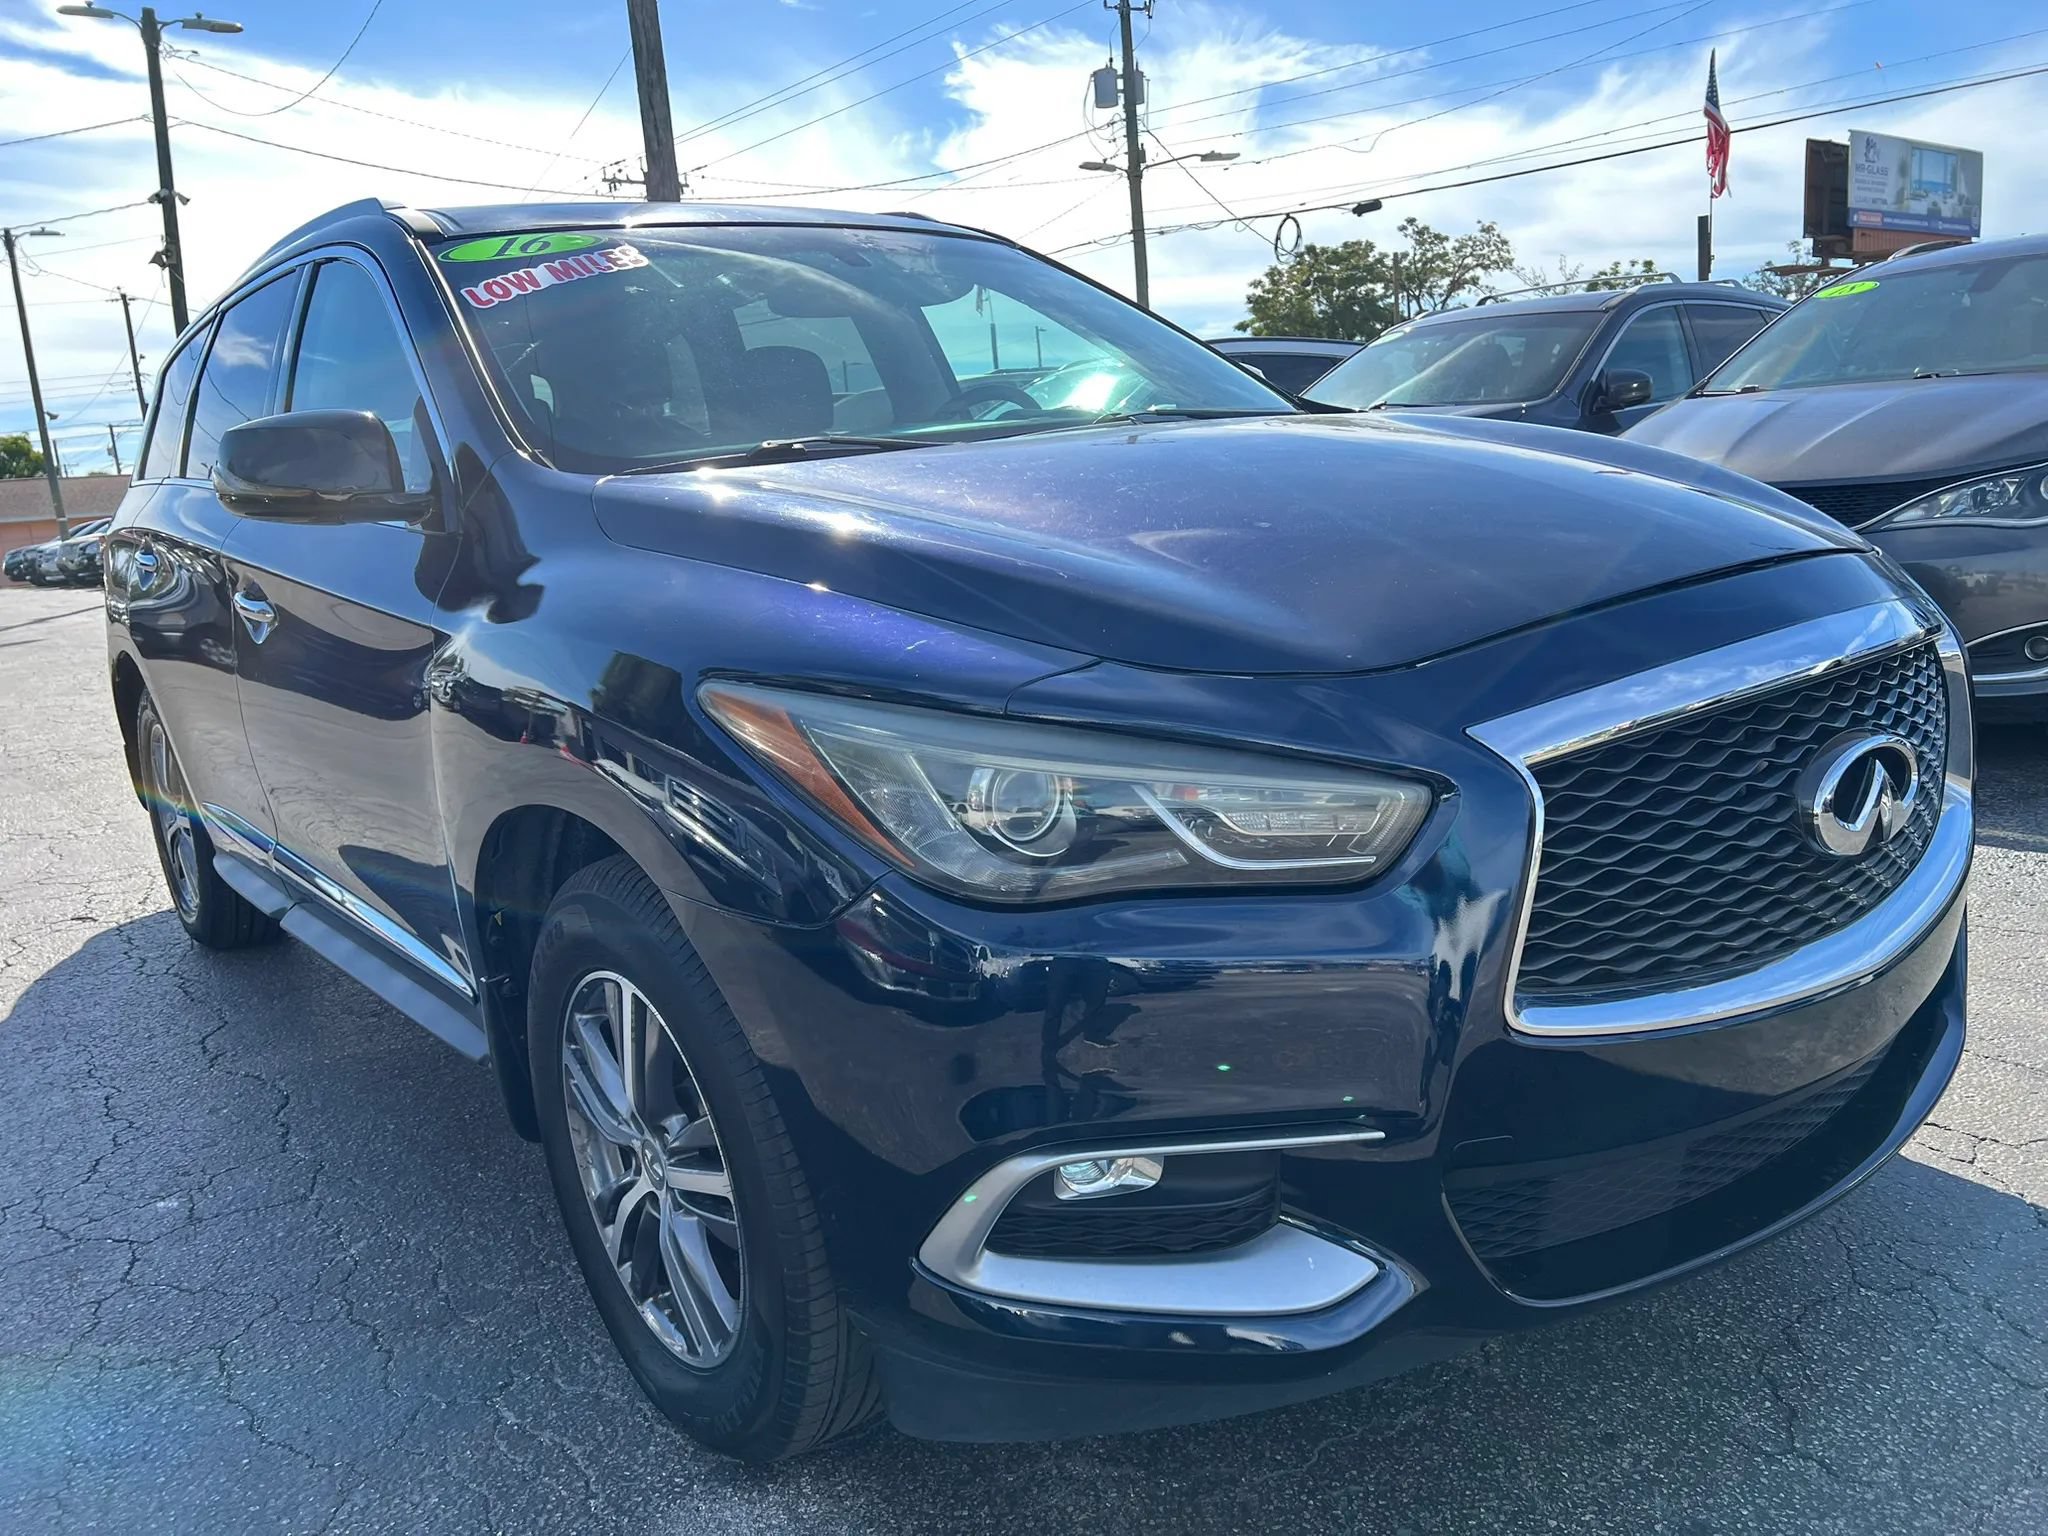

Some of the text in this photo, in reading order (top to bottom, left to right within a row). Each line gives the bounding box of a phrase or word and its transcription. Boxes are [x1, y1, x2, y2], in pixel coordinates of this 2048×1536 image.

[487, 235, 554, 259] 16
[464, 248, 645, 307] LOW MILES
